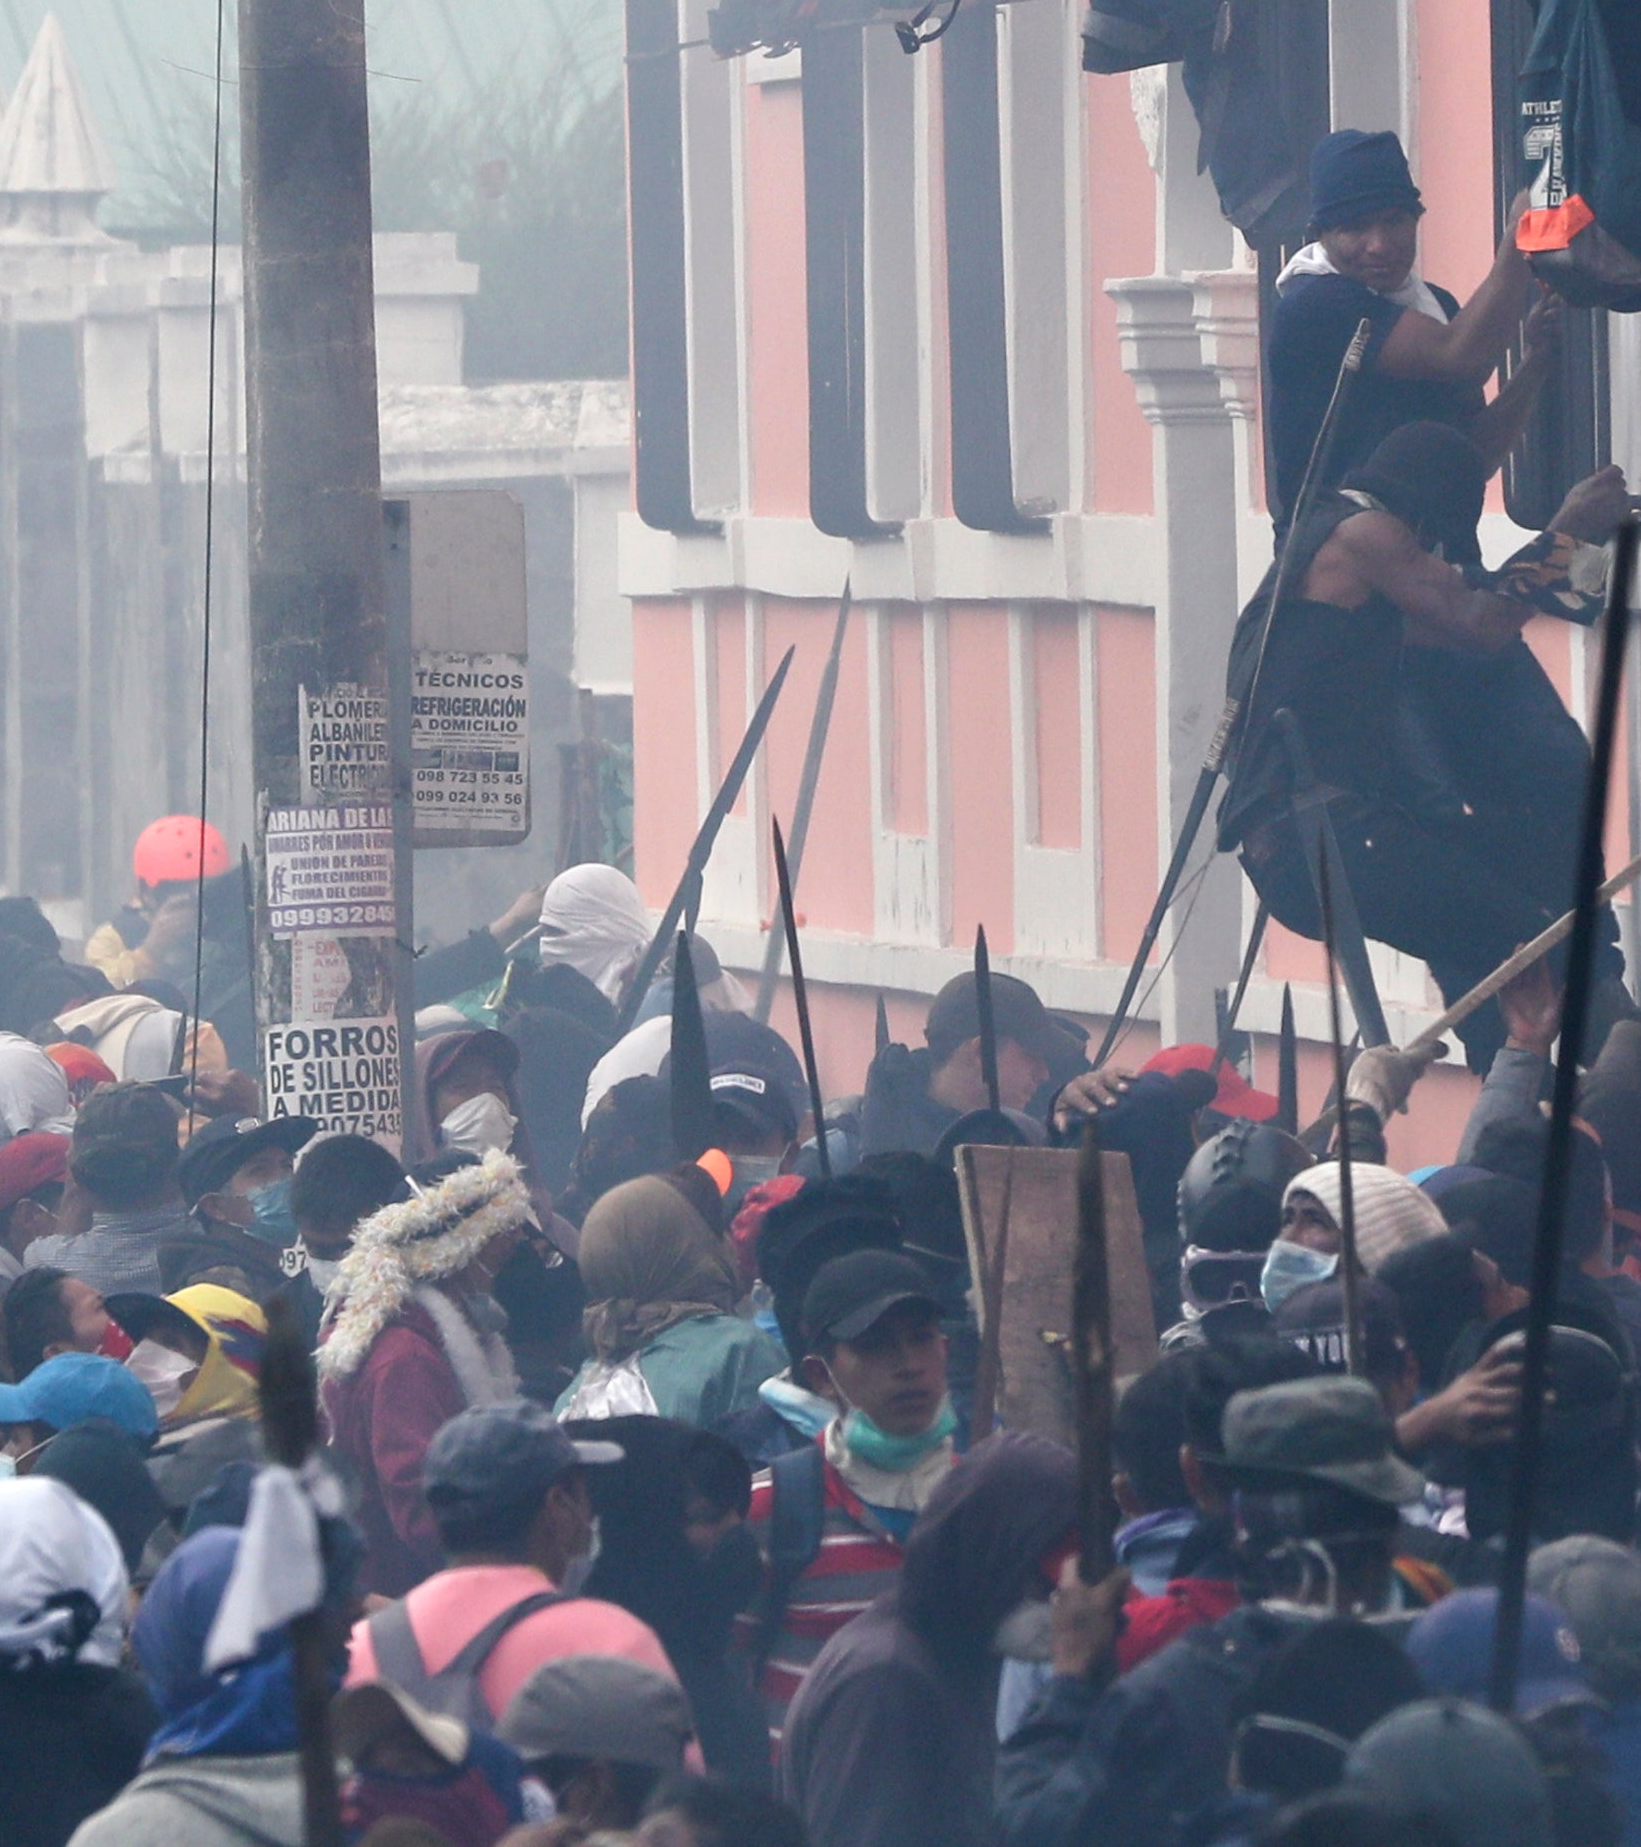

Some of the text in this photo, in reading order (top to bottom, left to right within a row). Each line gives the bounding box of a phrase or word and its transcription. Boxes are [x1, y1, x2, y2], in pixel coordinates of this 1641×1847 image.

[411, 695, 526, 718] REFRIGERACIÓN
[411, 719, 518, 733] A DOMICILIO
[417, 770, 523, 786] 098 723 55 45
[416, 790, 444, 803] 099
[449, 791, 477, 804] 024
[504, 794, 523, 806] 56
[344, 808, 368, 828] DE
[312, 834, 334, 851] POR
[332, 855, 349, 869] DE
[326, 885, 346, 900] DEL
[269, 1025, 397, 1062] FORROS
[270, 1057, 399, 1094] DE SILLONES
[273, 1089, 401, 1119] A MEDIDA
